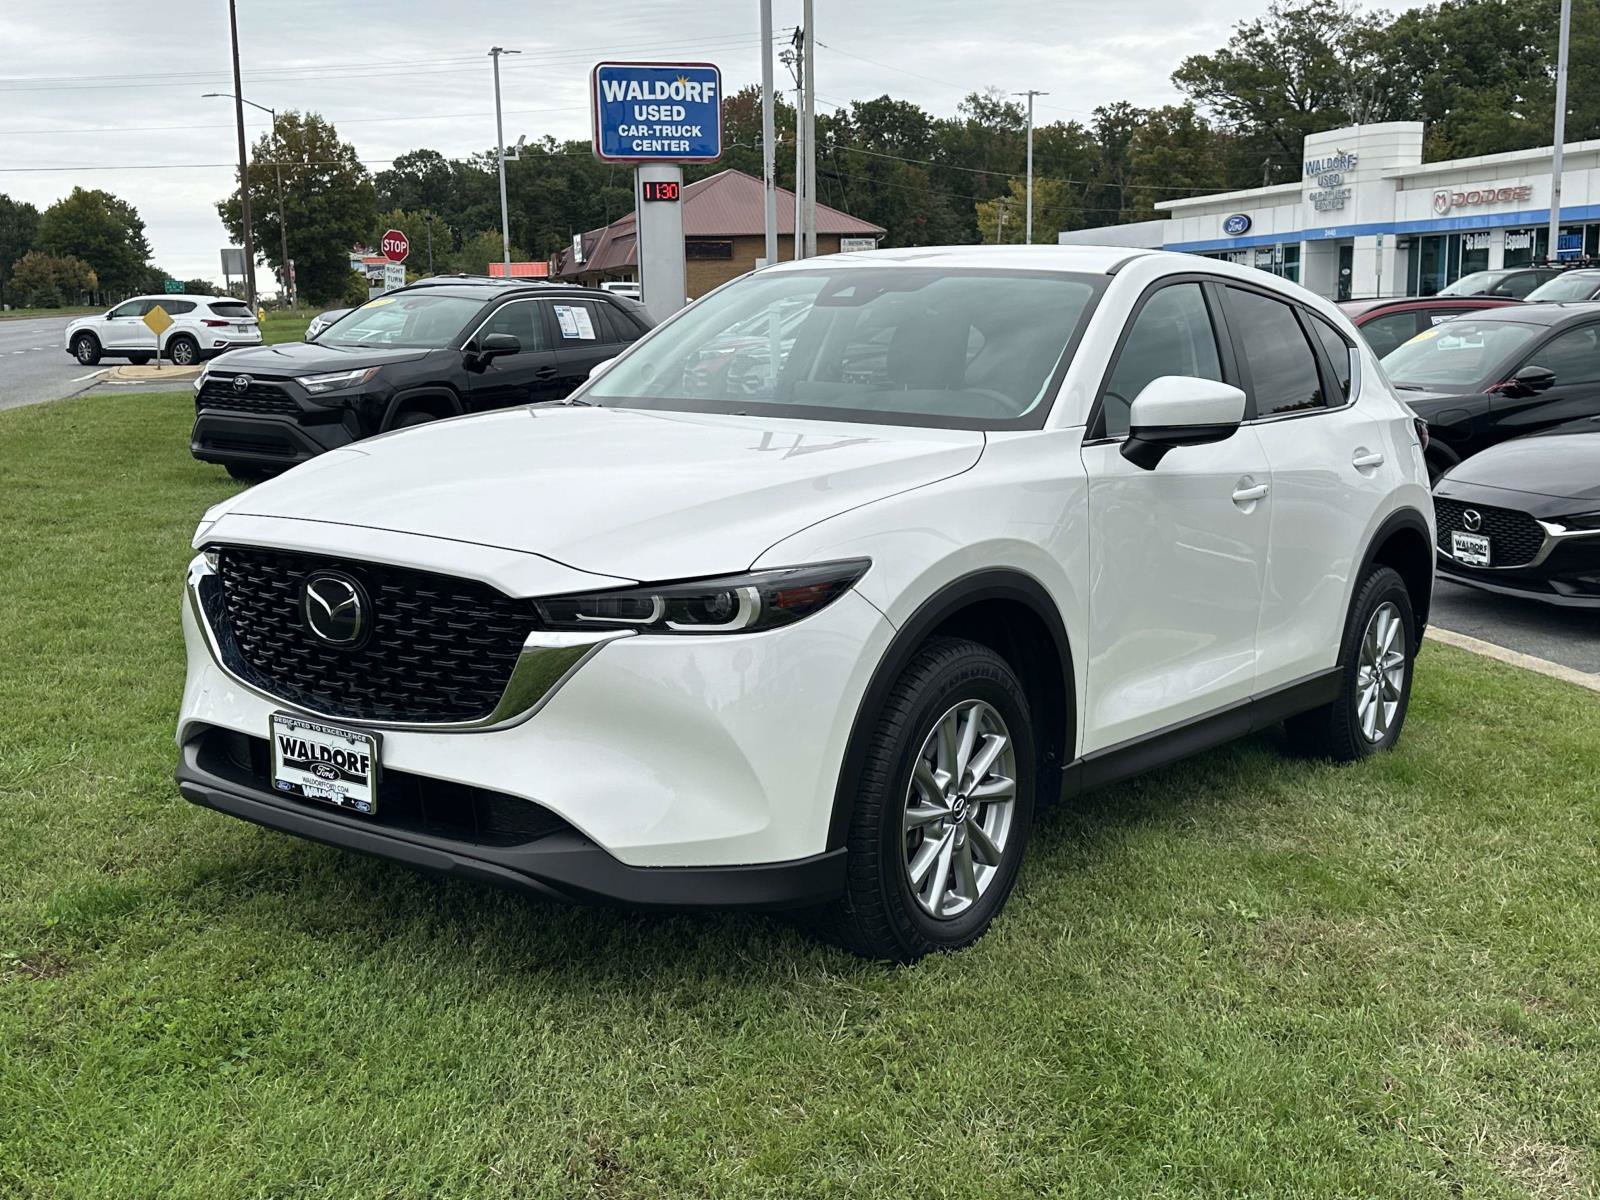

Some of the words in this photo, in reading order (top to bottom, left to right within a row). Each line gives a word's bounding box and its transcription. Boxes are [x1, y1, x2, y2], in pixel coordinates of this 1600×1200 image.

[602, 81, 716, 103] WALDORF
[634, 105, 686, 121] USED
[618, 125, 702, 137] CAR-TRUCK
[632, 139, 690, 152] CENTER
[1305, 153, 1358, 176] WALDORF
[1318, 173, 1340, 187] USED
[1451, 186, 1531, 208] DODGE
[384, 239, 407, 253] STOP
[386, 266, 404, 275] RIGHT
[387, 275, 403, 283] TURN
[1455, 539, 1487, 551] WALDORF
[274, 717, 310, 729] DEDICATED
[312, 724, 322, 732] TO
[323, 728, 366, 742] EXCELLENCE
[278, 735, 370, 774] WALDORF
[315, 764, 336, 780] Ford
[302, 776, 350, 793] WALDORFFORD.COM
[302, 784, 346, 806] WALDORF
